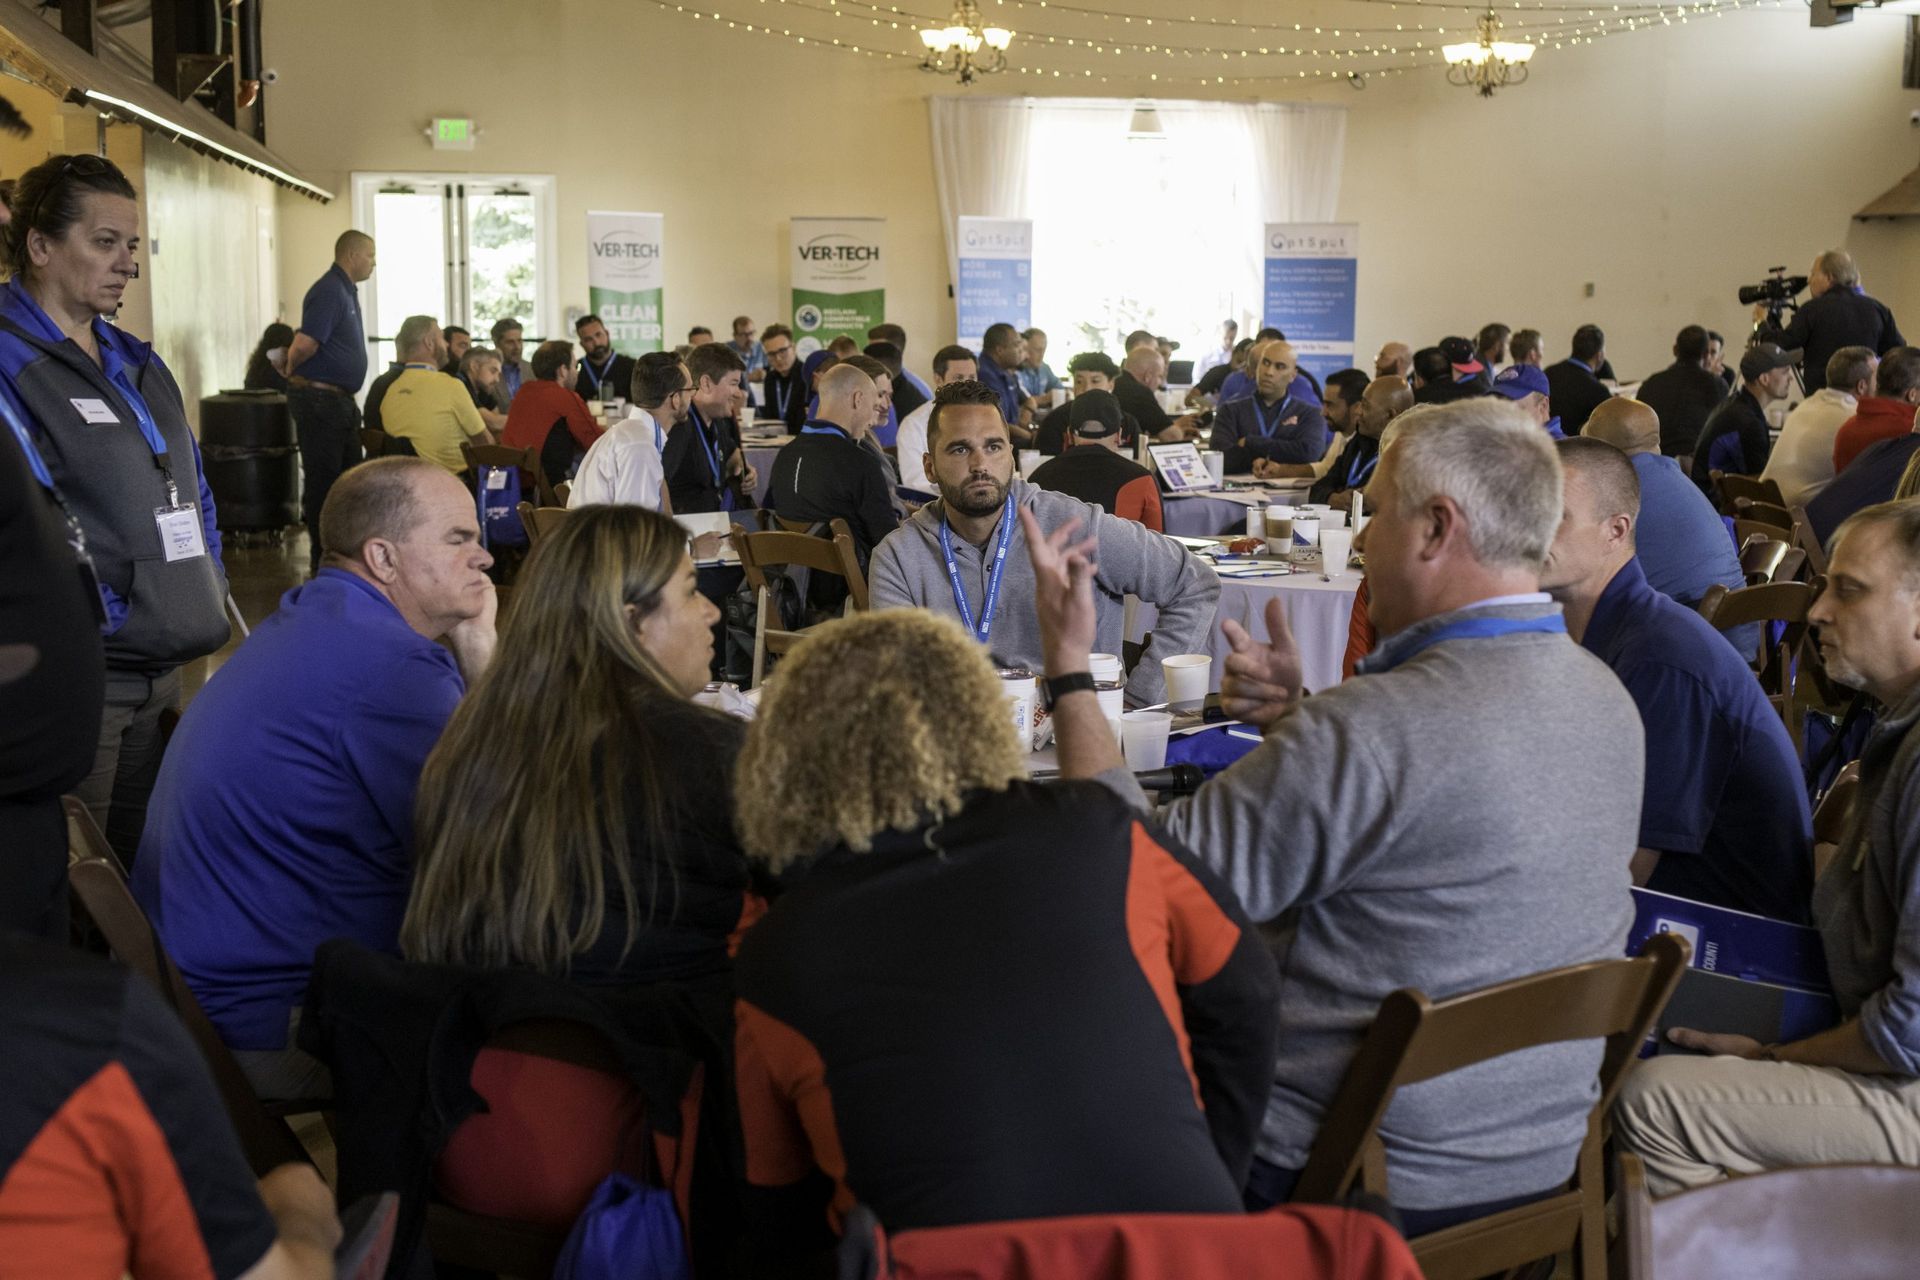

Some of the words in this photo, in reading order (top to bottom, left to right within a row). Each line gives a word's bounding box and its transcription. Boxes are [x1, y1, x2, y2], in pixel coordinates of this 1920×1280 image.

[439, 119, 468, 141] EXIT
[593, 242, 659, 258] VER-TECH
[798, 246, 879, 260] VER-TECH
[599, 304, 657, 321] CLEAN
[608, 323, 661, 340] ETTER
